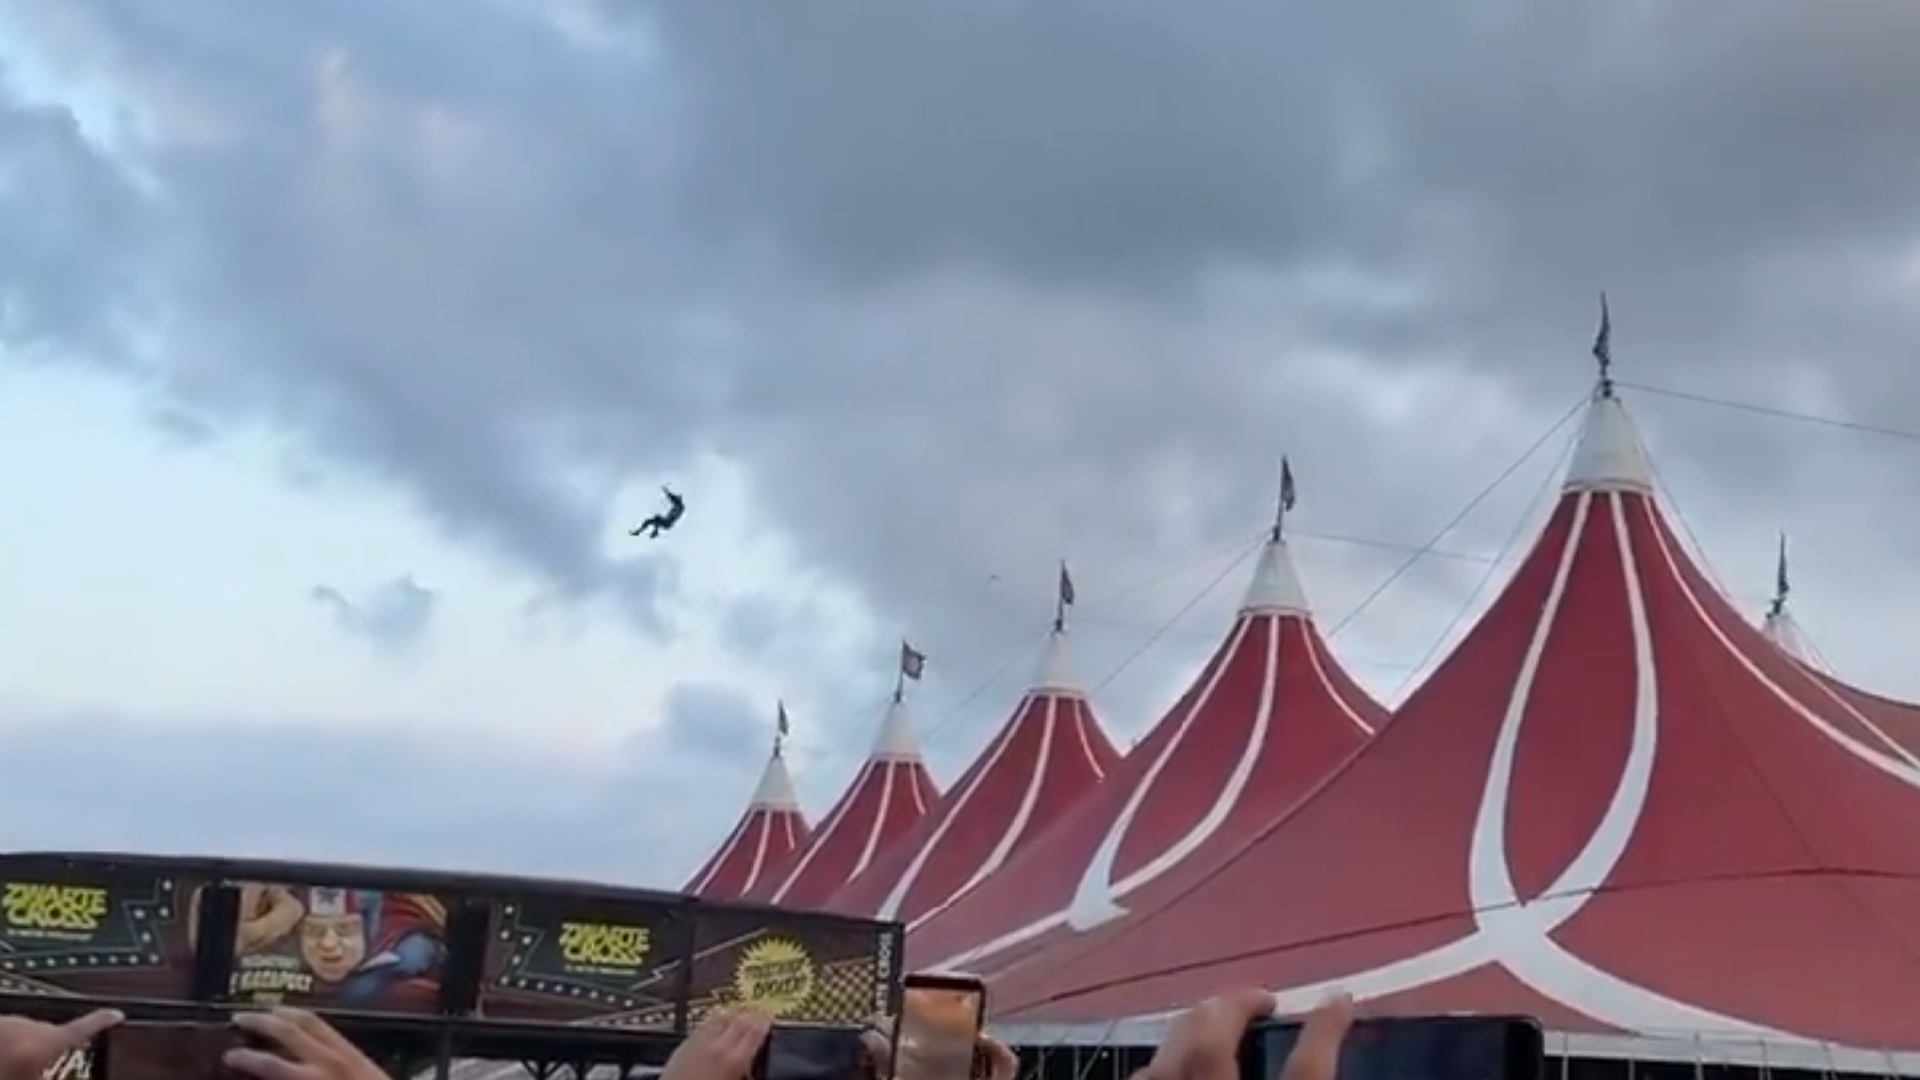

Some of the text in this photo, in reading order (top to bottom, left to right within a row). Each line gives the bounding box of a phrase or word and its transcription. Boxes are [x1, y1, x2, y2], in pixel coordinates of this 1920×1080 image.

[2, 883, 107, 914] ZWARTE
[7, 906, 98, 929] CROSS
[559, 922, 650, 951] ZWARTE
[564, 944, 642, 965] CROSS
